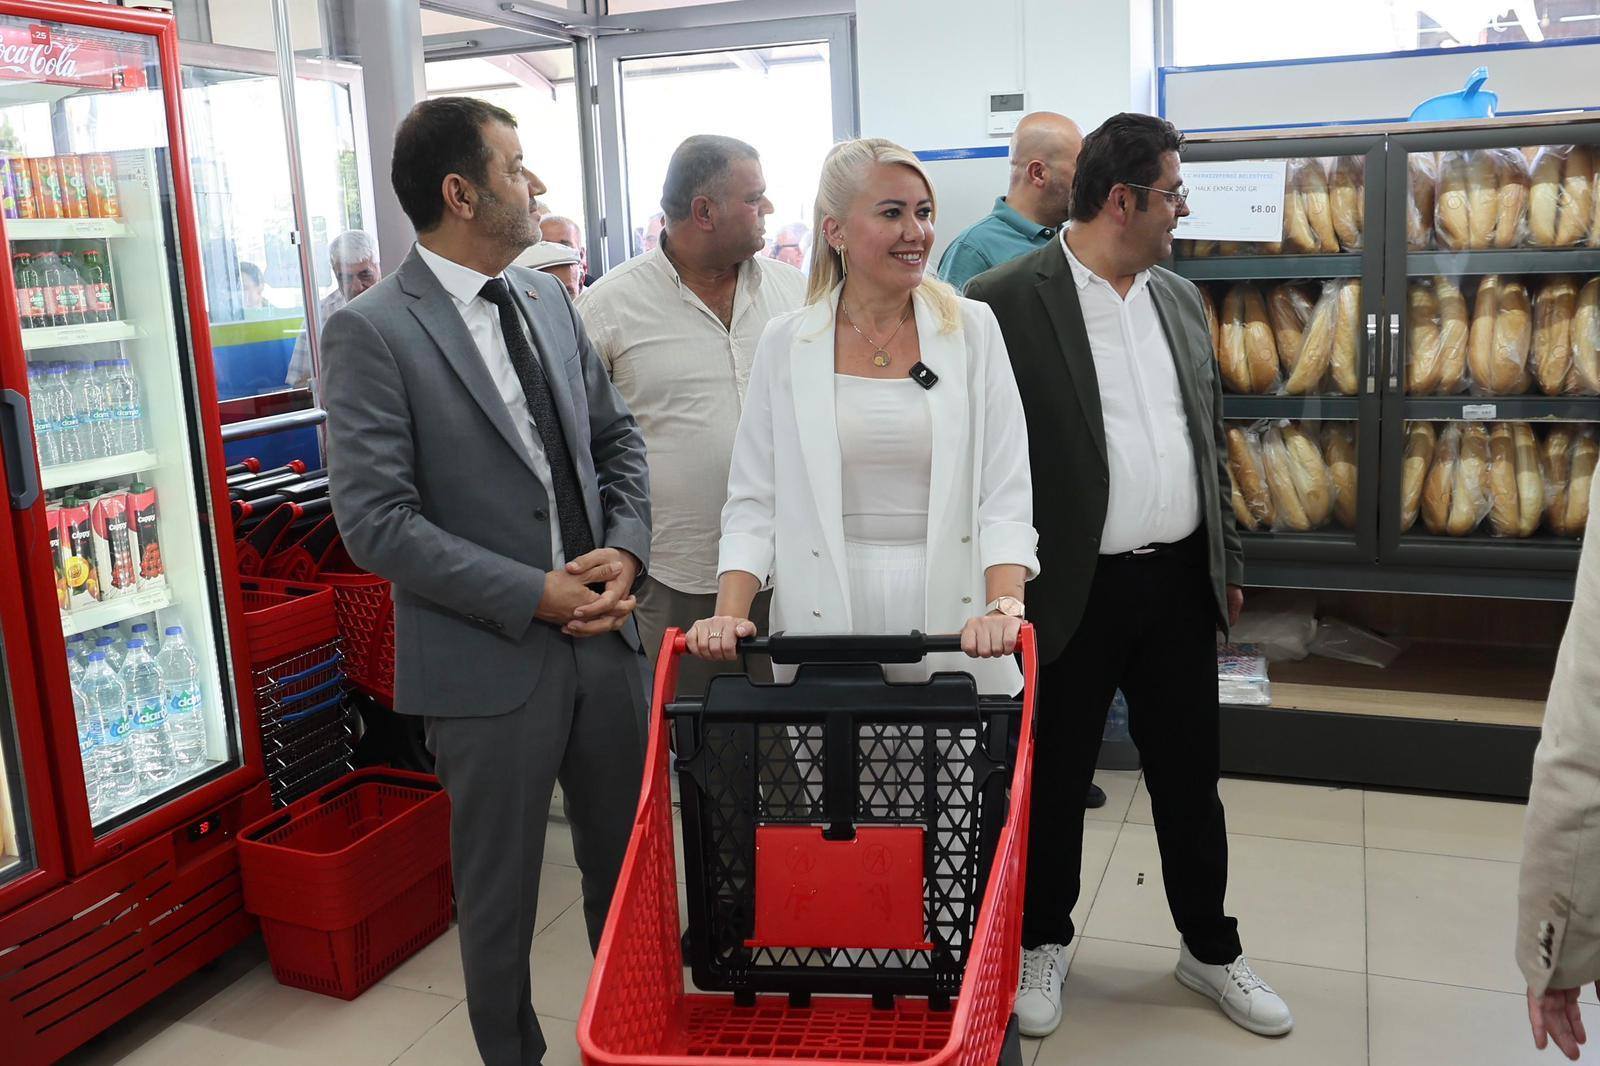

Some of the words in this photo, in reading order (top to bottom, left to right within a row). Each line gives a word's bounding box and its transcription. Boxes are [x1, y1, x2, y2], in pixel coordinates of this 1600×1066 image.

[0, 41, 79, 78] oca-Cola
[138, 514, 156, 523] Cappy
[109, 521, 128, 531] Cappy
[72, 530, 91, 540] Cappy
